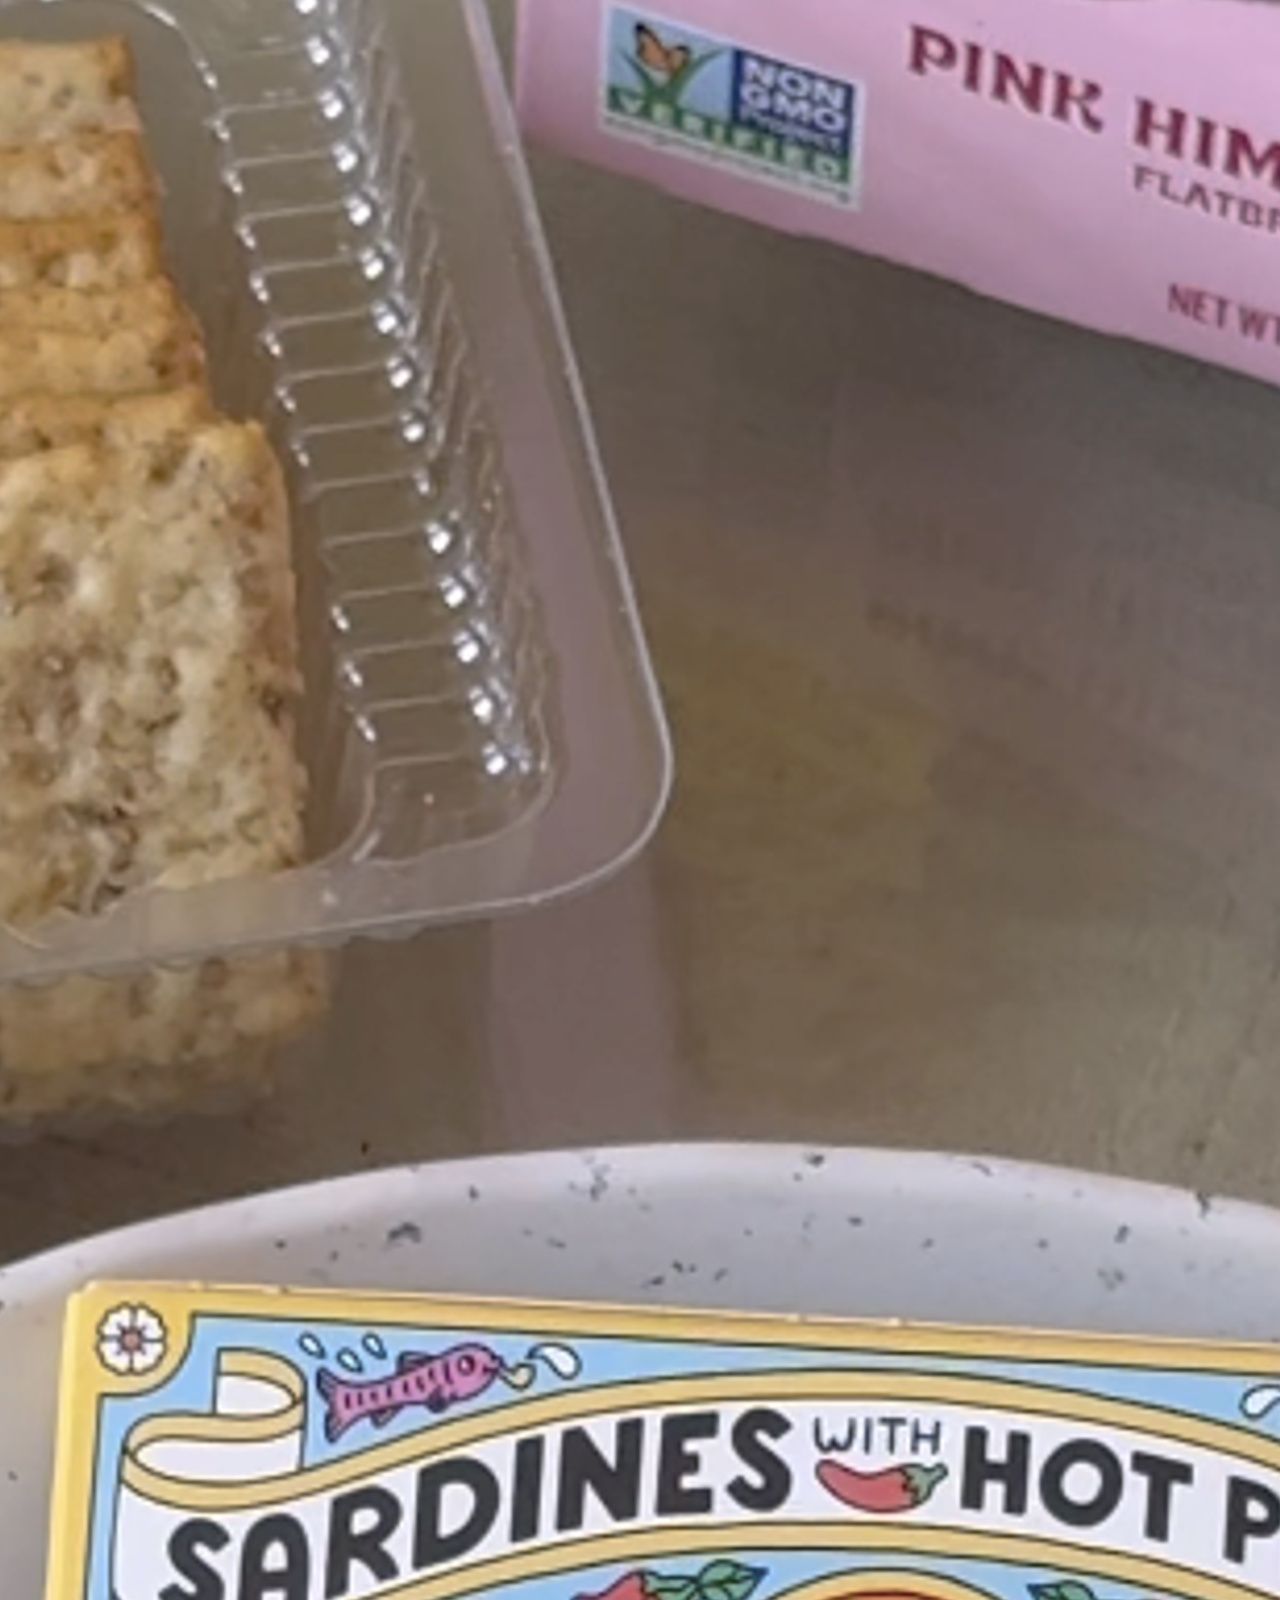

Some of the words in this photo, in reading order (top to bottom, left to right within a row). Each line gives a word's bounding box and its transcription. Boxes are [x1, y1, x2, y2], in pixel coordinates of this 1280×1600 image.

[739, 83, 845, 133] GMO
[744, 59, 846, 108] NON
[908, 24, 1104, 133] PINK
[619, 94, 840, 179] VERIFIED
[1168, 283, 1228, 331] NET
[813, 1416, 941, 1456] WITH
[960, 1426, 1194, 1543] HOT
